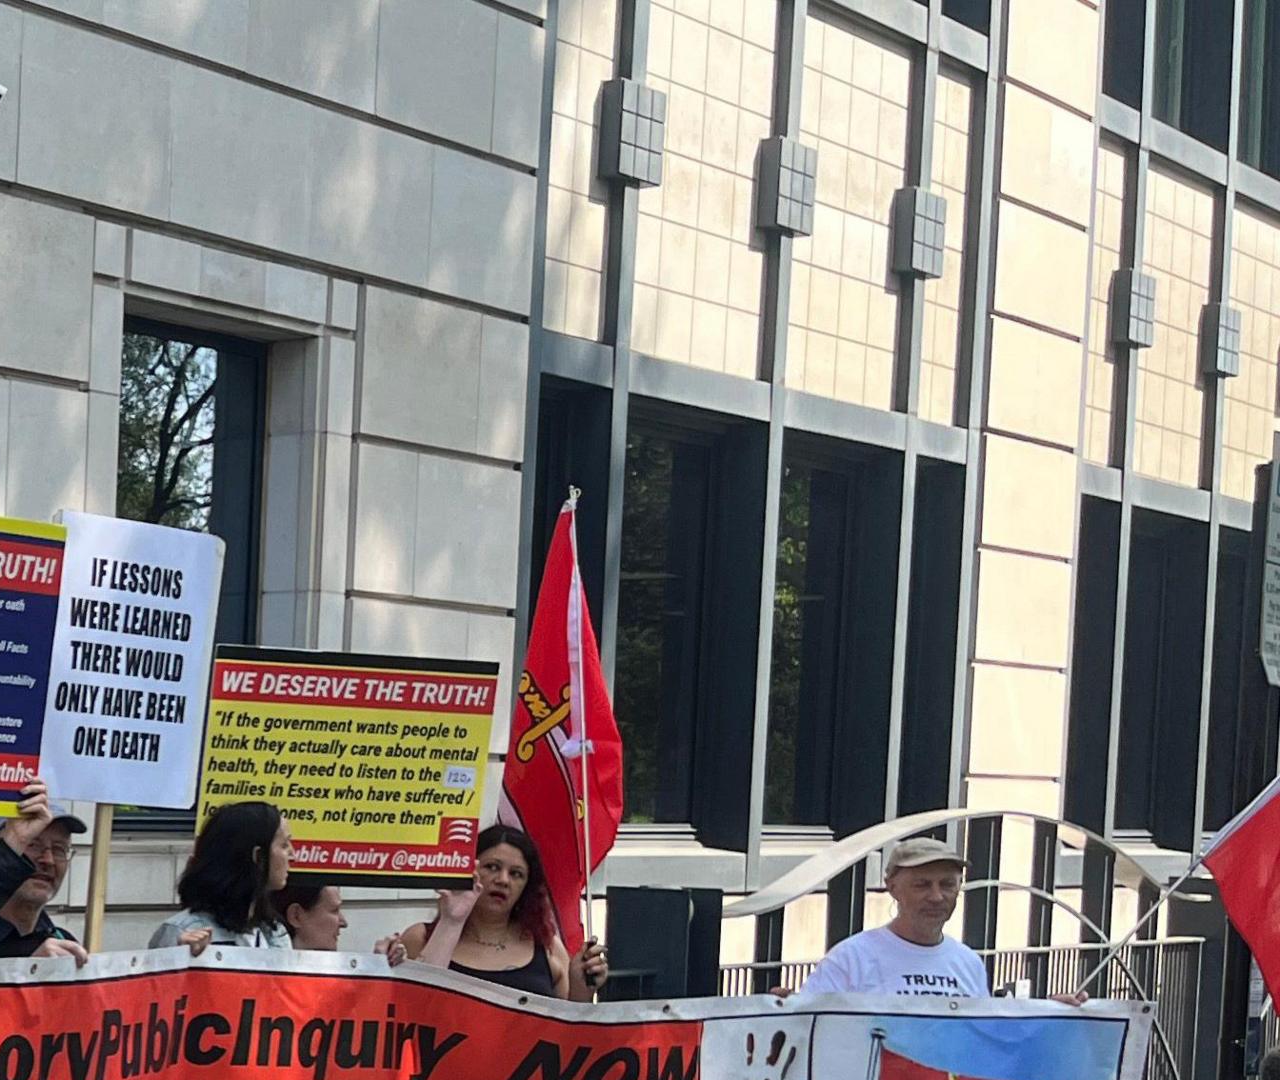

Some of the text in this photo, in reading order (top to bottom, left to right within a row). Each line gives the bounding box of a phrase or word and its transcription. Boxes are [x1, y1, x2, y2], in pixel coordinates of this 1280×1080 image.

[91, 558, 183, 600] IF LESSONS
[71, 598, 191, 642] WERE LEARNED
[70, 640, 183, 682] THERE WOULD
[55, 682, 185, 724] ONLY HAVE BEEN
[222, 671, 490, 707] WE DESERVE THE TRUTH!
[236, 712, 467, 741] the government wants people to
[73, 727, 159, 762] ONE DEATH
[211, 735, 479, 762] think they actually care about mental
[208, 758, 441, 782] health, they need to listen to the
[206, 779, 463, 806] families in Essex who have suffered
[322, 811, 396, 826] not ignore
[332, 847, 470, 869] Inquiry @eputnhs
[902, 975, 958, 987] TRUTH
